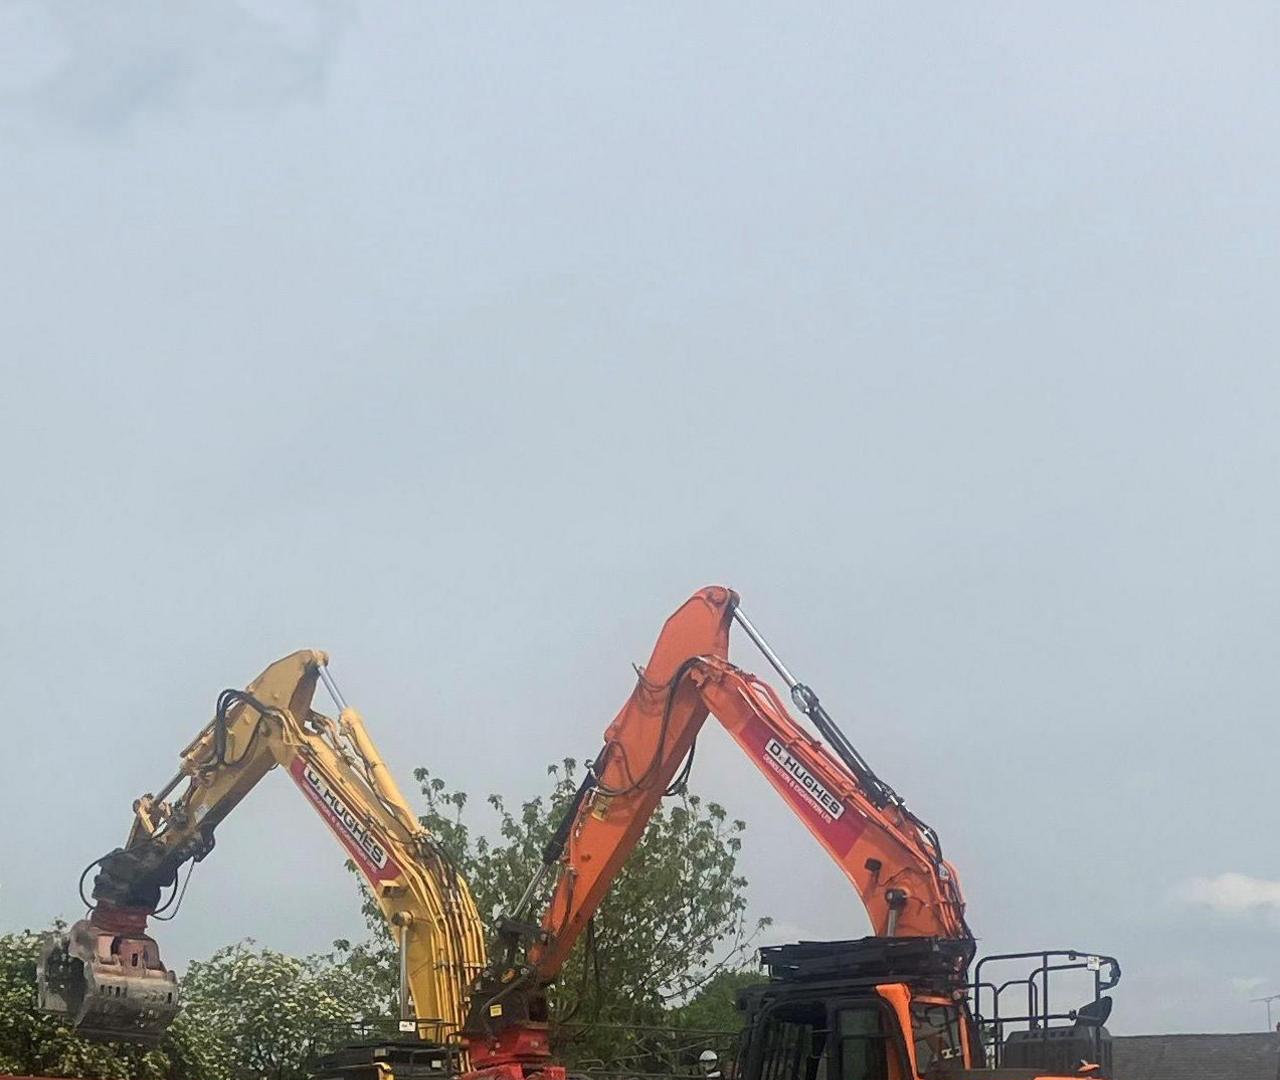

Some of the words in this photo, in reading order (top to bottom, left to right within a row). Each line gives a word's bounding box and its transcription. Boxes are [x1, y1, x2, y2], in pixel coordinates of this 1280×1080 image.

[770, 742, 783, 760] D.
[784, 756, 840, 815] HUGHES
[323, 788, 384, 864] HUGHES
